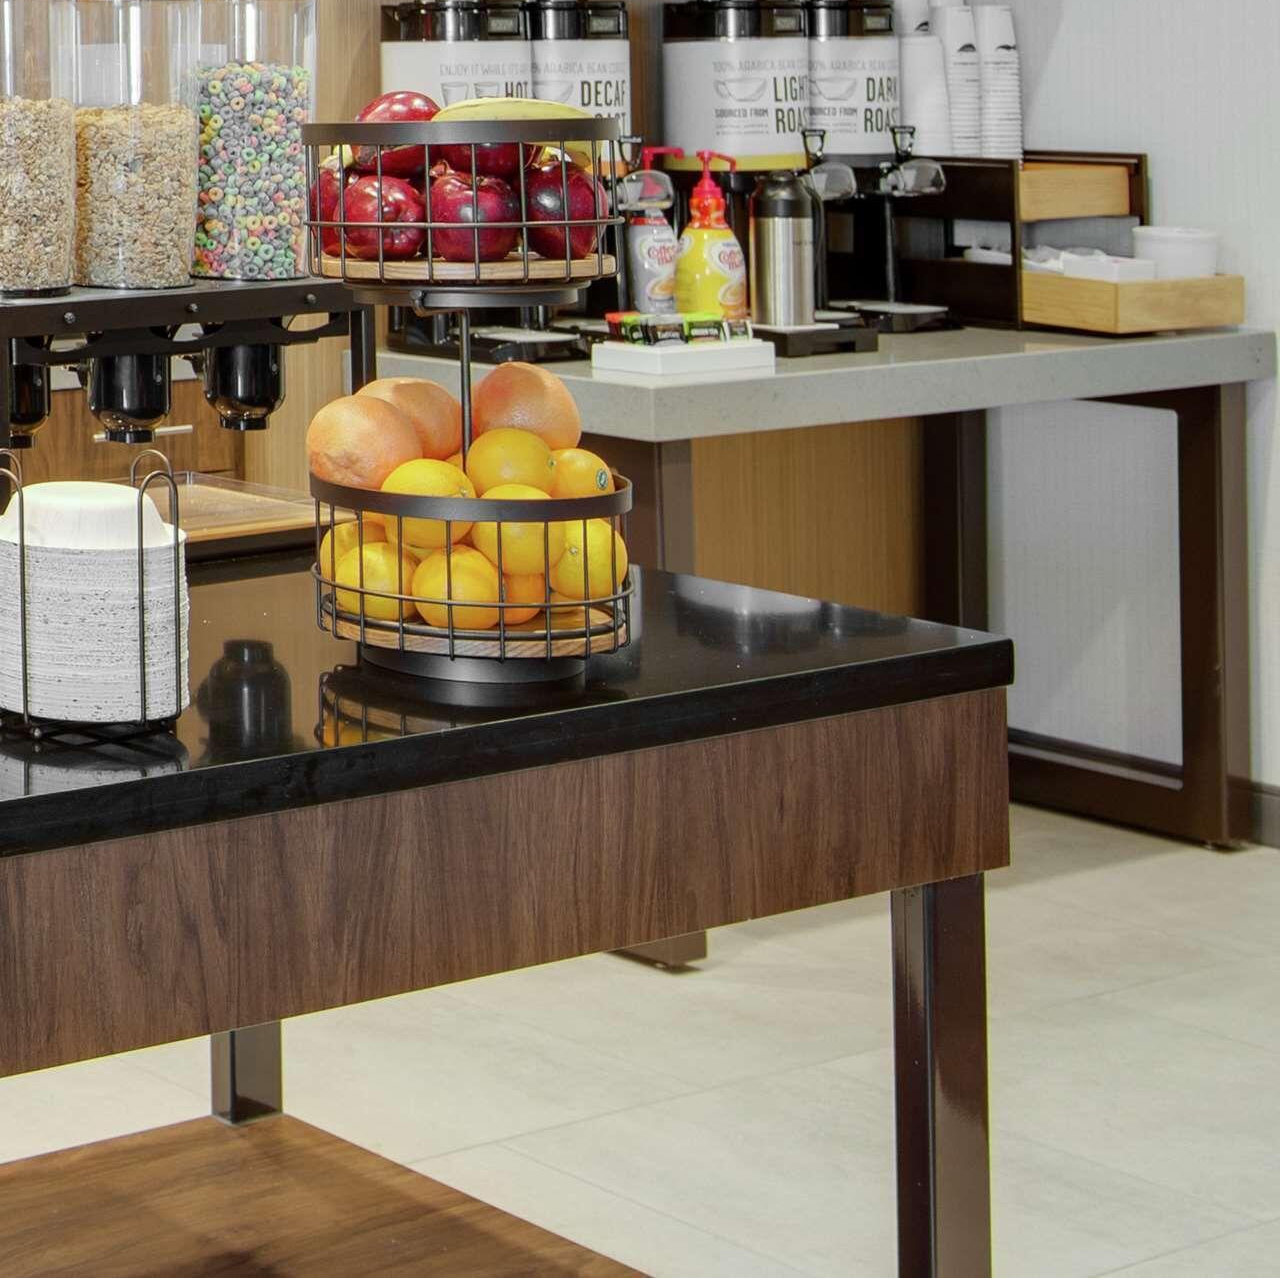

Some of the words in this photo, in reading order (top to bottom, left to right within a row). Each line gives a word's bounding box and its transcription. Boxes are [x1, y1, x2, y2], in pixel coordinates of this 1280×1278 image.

[581, 80, 625, 107] DECAF
[775, 107, 808, 133] ROAS
[864, 108, 898, 133] ROAS
